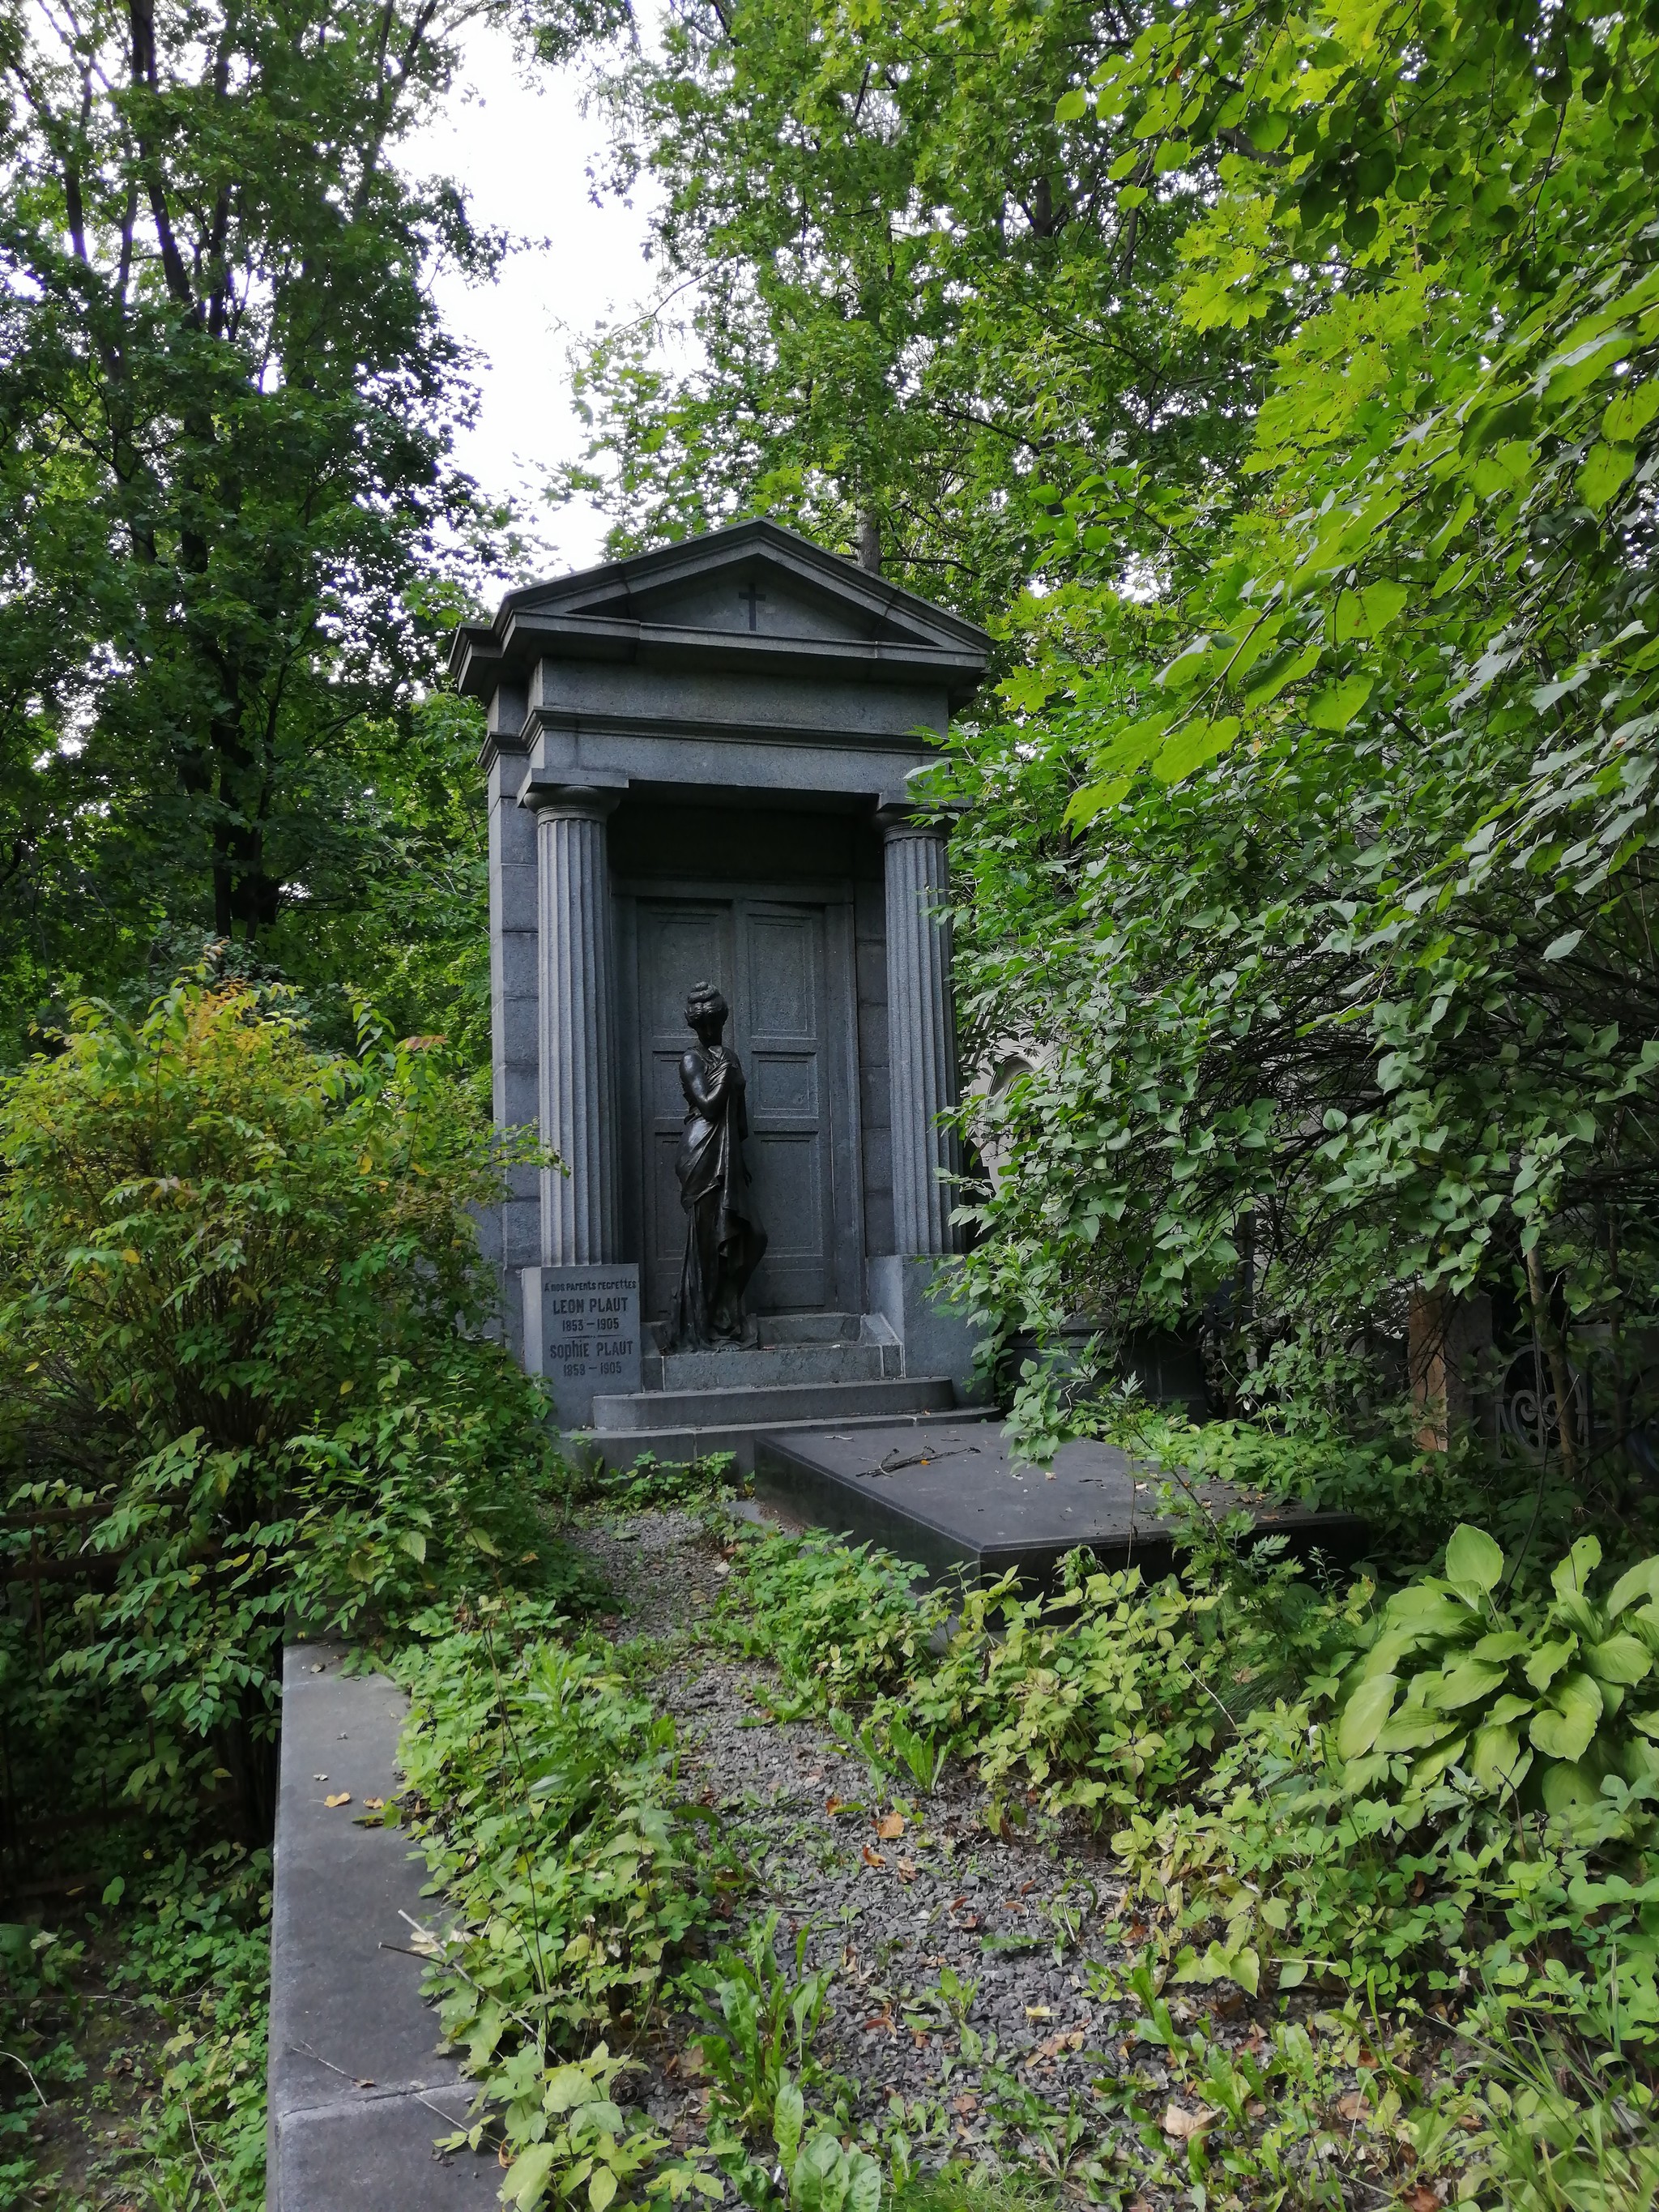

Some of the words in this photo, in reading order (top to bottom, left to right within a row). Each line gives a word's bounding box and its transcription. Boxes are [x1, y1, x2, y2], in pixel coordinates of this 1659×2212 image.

[553, 1298, 584, 1315] LEON
[590, 1297, 628, 1313] PLAUT
[562, 1319, 584, 1331] 1853
[597, 1317, 619, 1330] 1905
[596, 1340, 633, 1356] PLAUT
[600, 1361, 622, 1374] 1905
